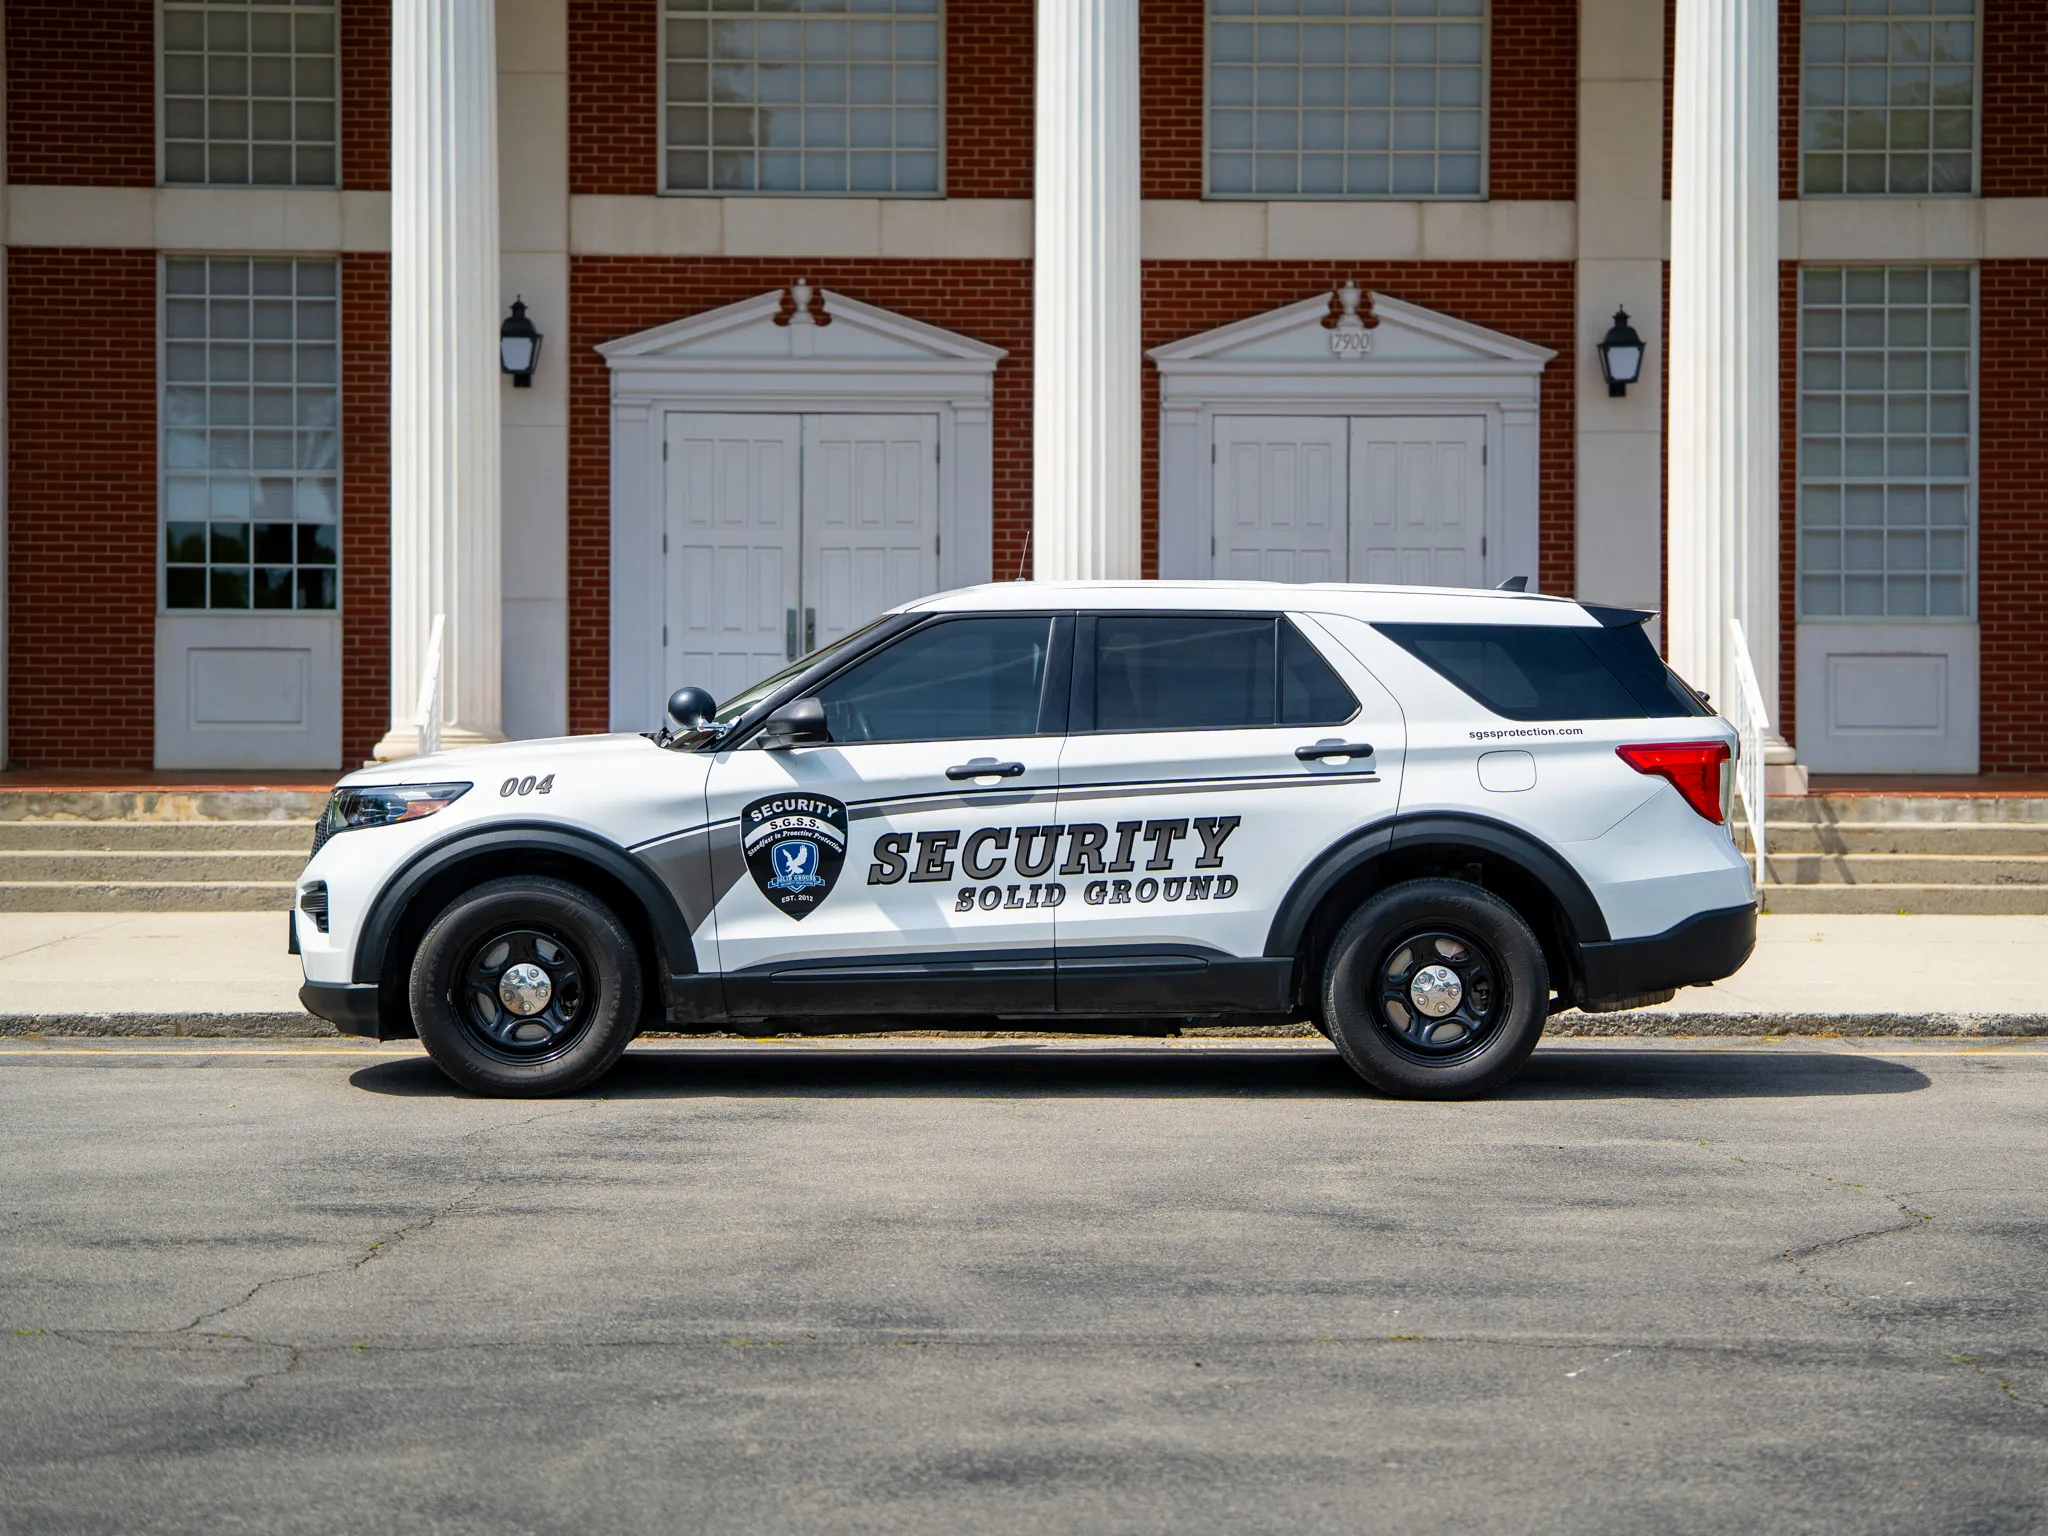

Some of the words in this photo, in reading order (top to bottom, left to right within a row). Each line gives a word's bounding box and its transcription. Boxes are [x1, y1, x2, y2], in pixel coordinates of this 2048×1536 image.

[1335, 332, 1370, 350] 7900
[1469, 727, 1583, 740] sgssprotection.com
[500, 773, 556, 798] 004
[750, 799, 839, 822] SECURITY
[770, 818, 820, 830] S.G.S.S.
[747, 835, 774, 857] Steadfast
[774, 832, 781, 840] in
[782, 830, 812, 838] Proactive
[813, 832, 842, 854] Protection
[867, 815, 1242, 886] SECURITY
[781, 895, 797, 903] EST.
[955, 882, 1066, 912] SOLID
[1083, 874, 1240, 906] GROUND
